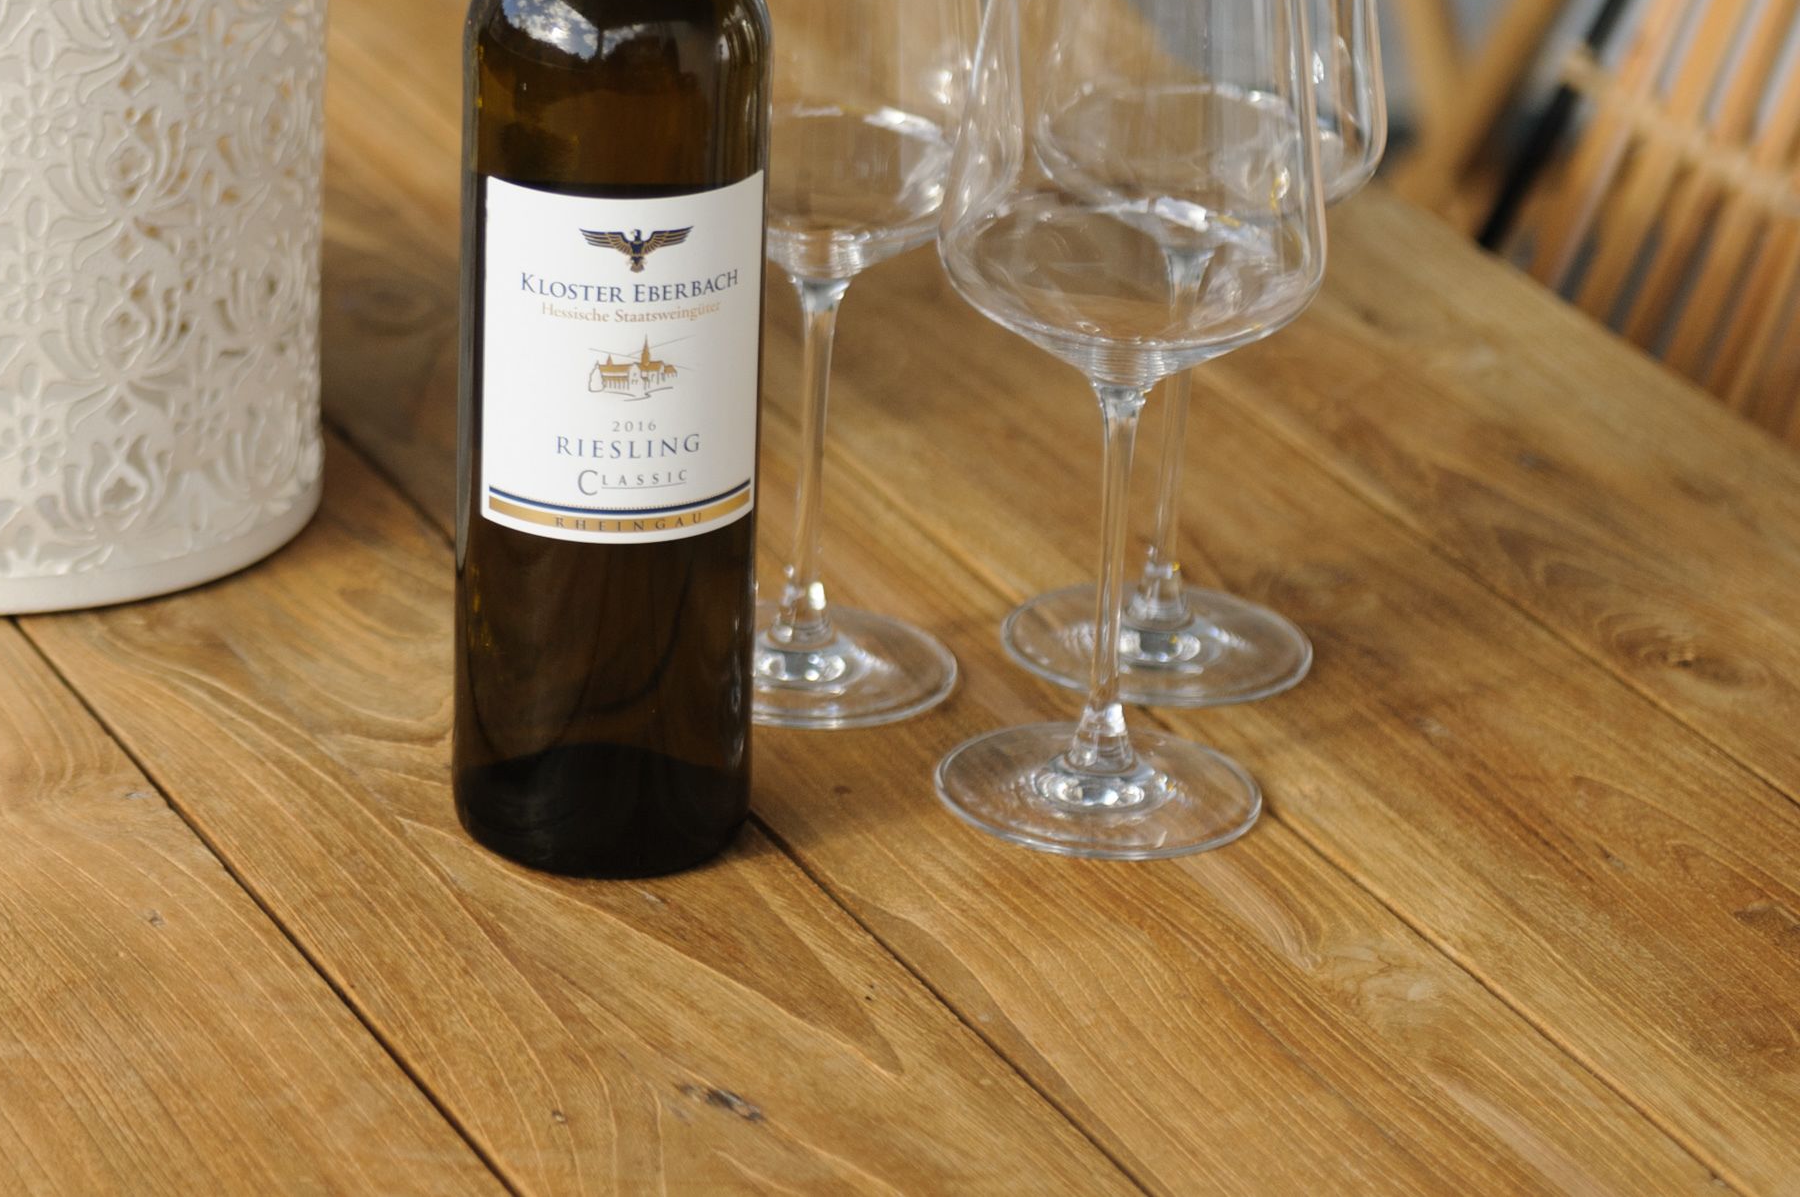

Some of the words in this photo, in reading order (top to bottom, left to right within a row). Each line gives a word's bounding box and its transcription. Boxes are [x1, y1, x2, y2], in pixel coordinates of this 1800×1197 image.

[520, 272, 626, 303] KLOSTER
[633, 268, 739, 303] EBERBACH
[542, 302, 609, 322] Hessische
[612, 420, 657, 432] 2016
[556, 434, 701, 459] RIESLING
[577, 469, 688, 496] CLASSIC
[555, 513, 703, 531] RHEINGAU
